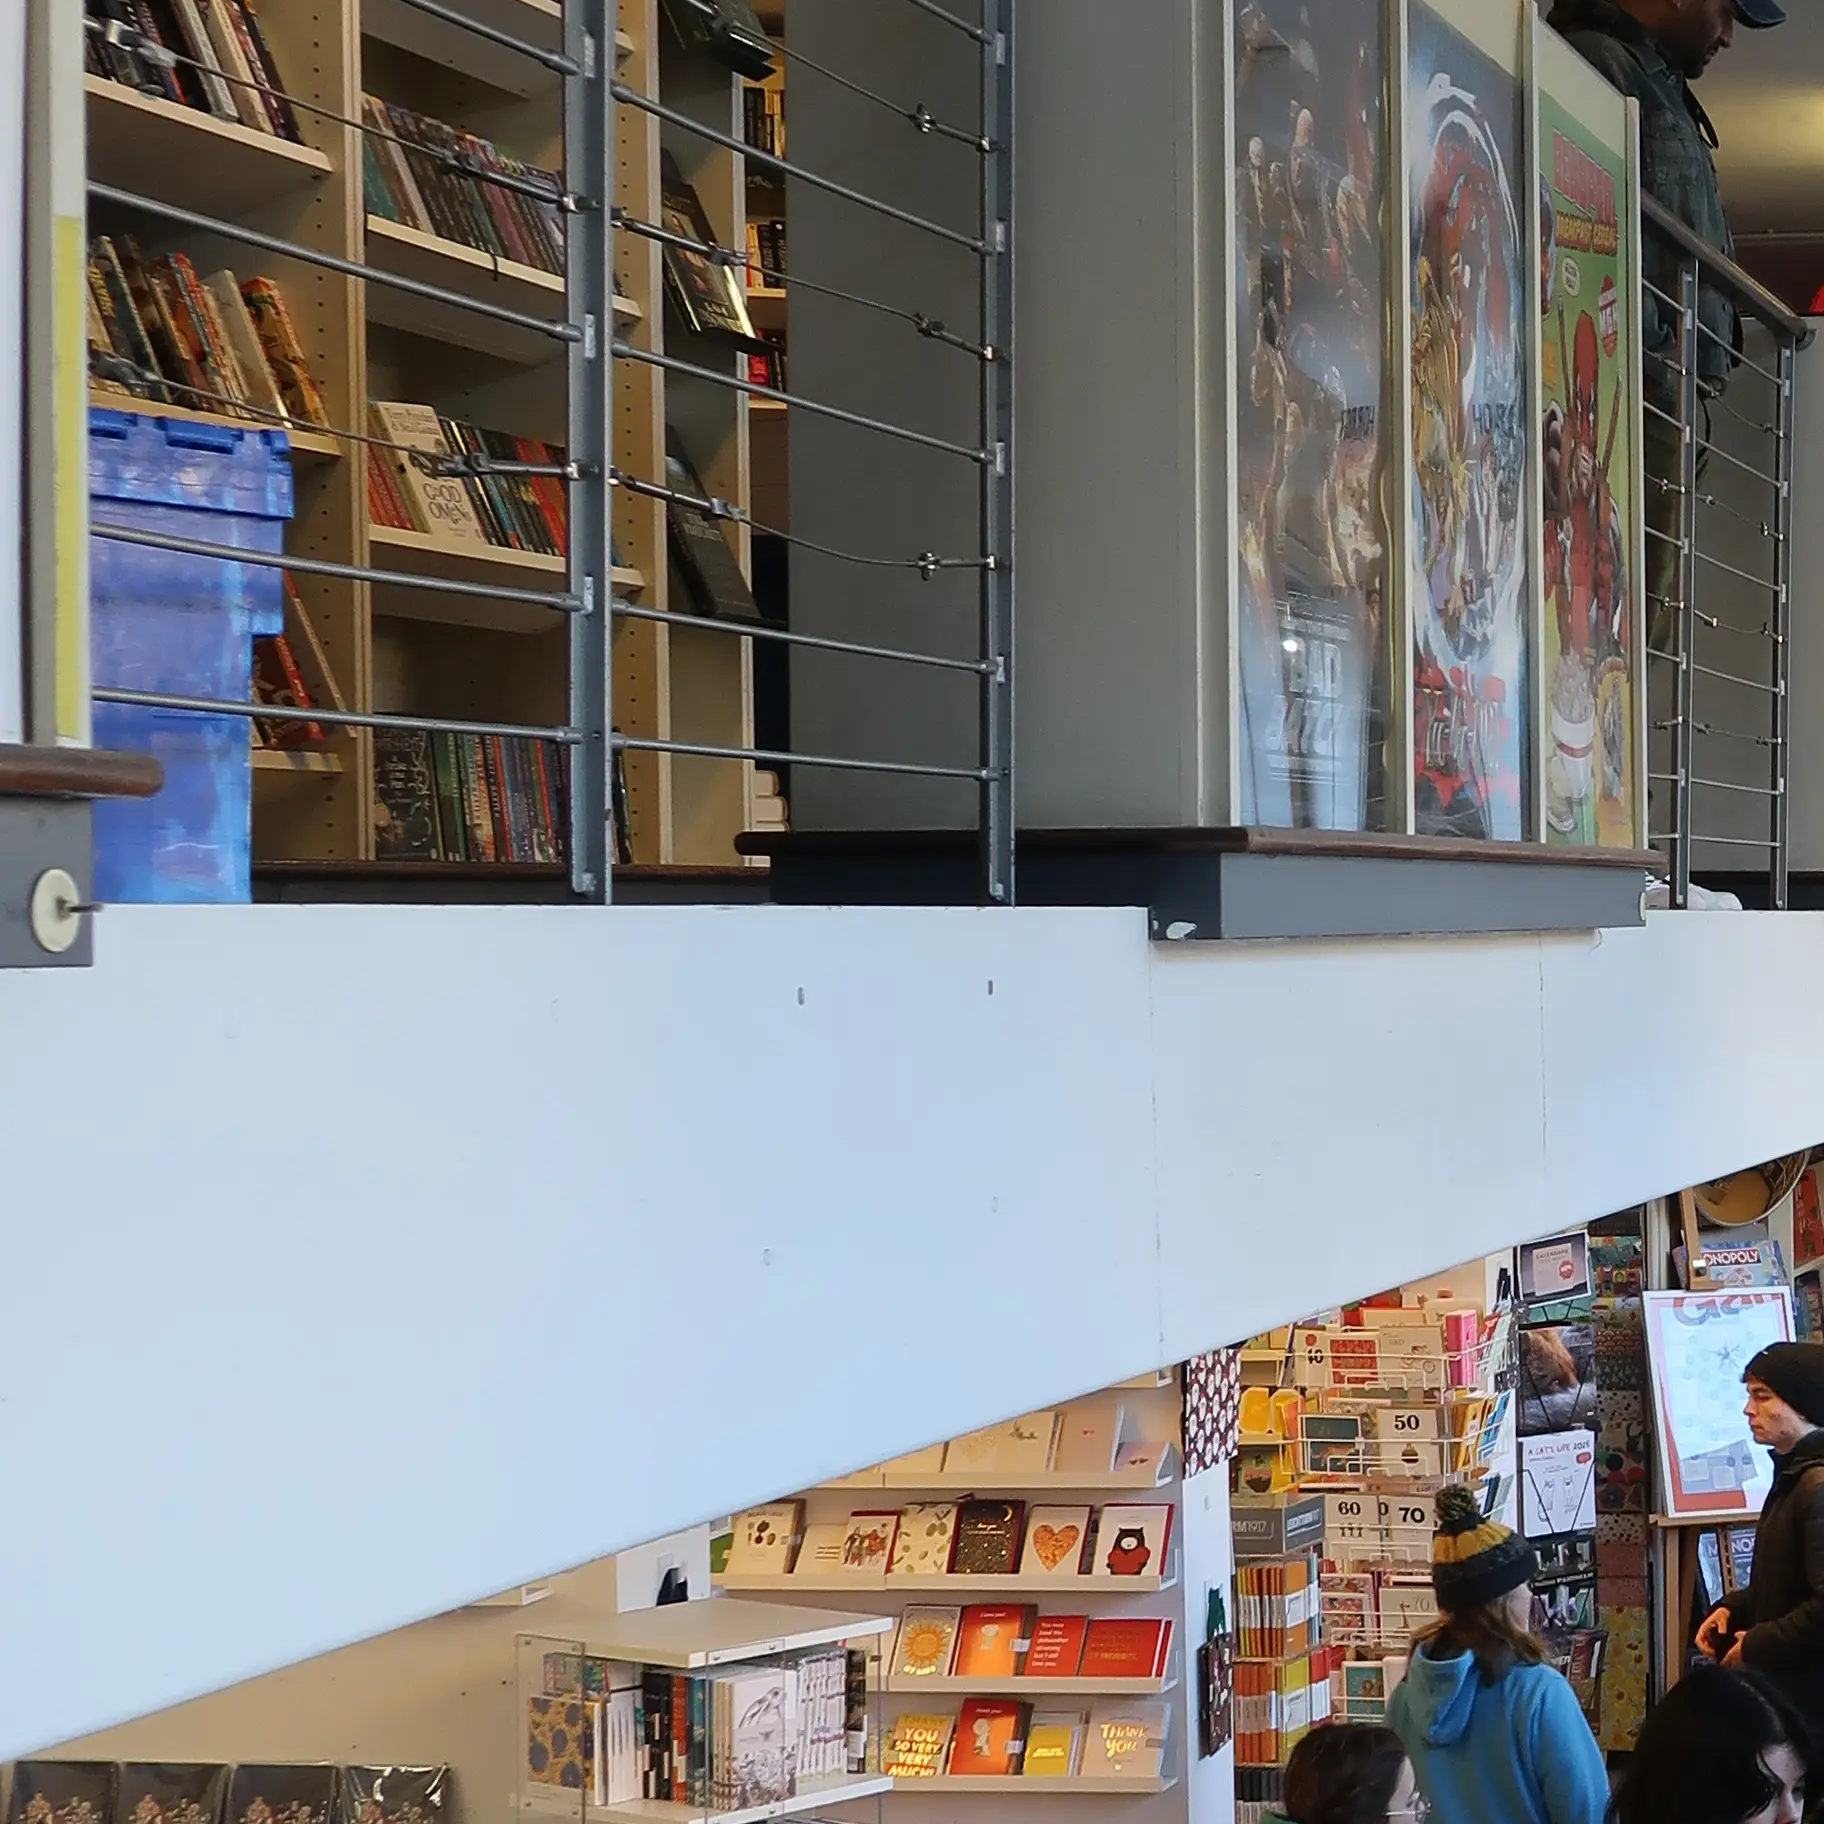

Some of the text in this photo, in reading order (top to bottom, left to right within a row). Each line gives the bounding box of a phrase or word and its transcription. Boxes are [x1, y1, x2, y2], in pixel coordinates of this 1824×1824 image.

[422, 480, 463, 503] GOOD
[1703, 1247, 1760, 1267] ONOPOLY
[1393, 1414, 1421, 1432] 50
[1527, 1448, 1535, 1458] A
[1338, 1501, 1361, 1517] 60
[1398, 1507, 1426, 1524] 70
[904, 1727, 939, 1742] YOU
[1100, 1723, 1149, 1740] THANK
[894, 1740, 941, 1754] SO VERY
[1105, 1738, 1138, 1758] YOU
[897, 1753, 933, 1766] VERY
[886, 1765, 937, 1777] MUCH!
